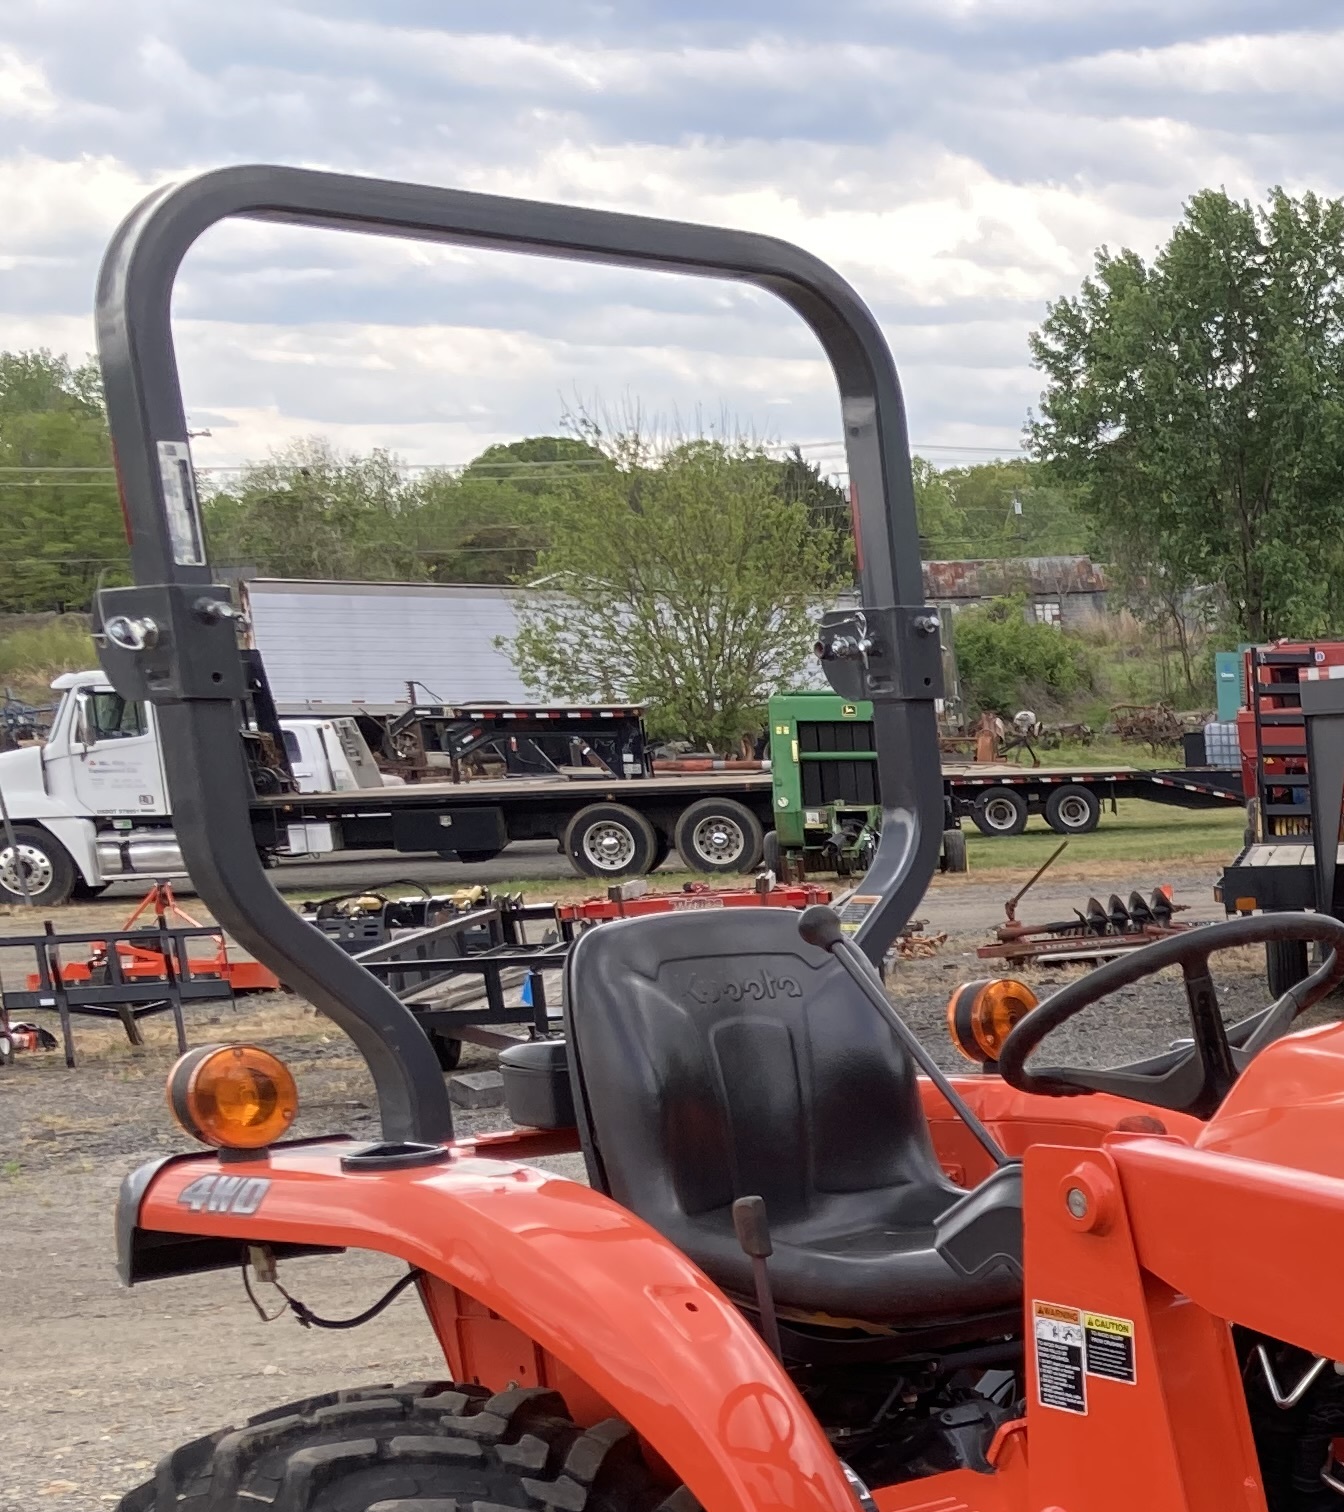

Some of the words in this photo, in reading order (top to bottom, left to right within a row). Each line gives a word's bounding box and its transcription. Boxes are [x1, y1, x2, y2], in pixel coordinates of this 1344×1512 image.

[176, 1172, 272, 1217] 4WD
[1044, 1307, 1079, 1322] WARNING
[1094, 1318, 1130, 1334] CAUTION
